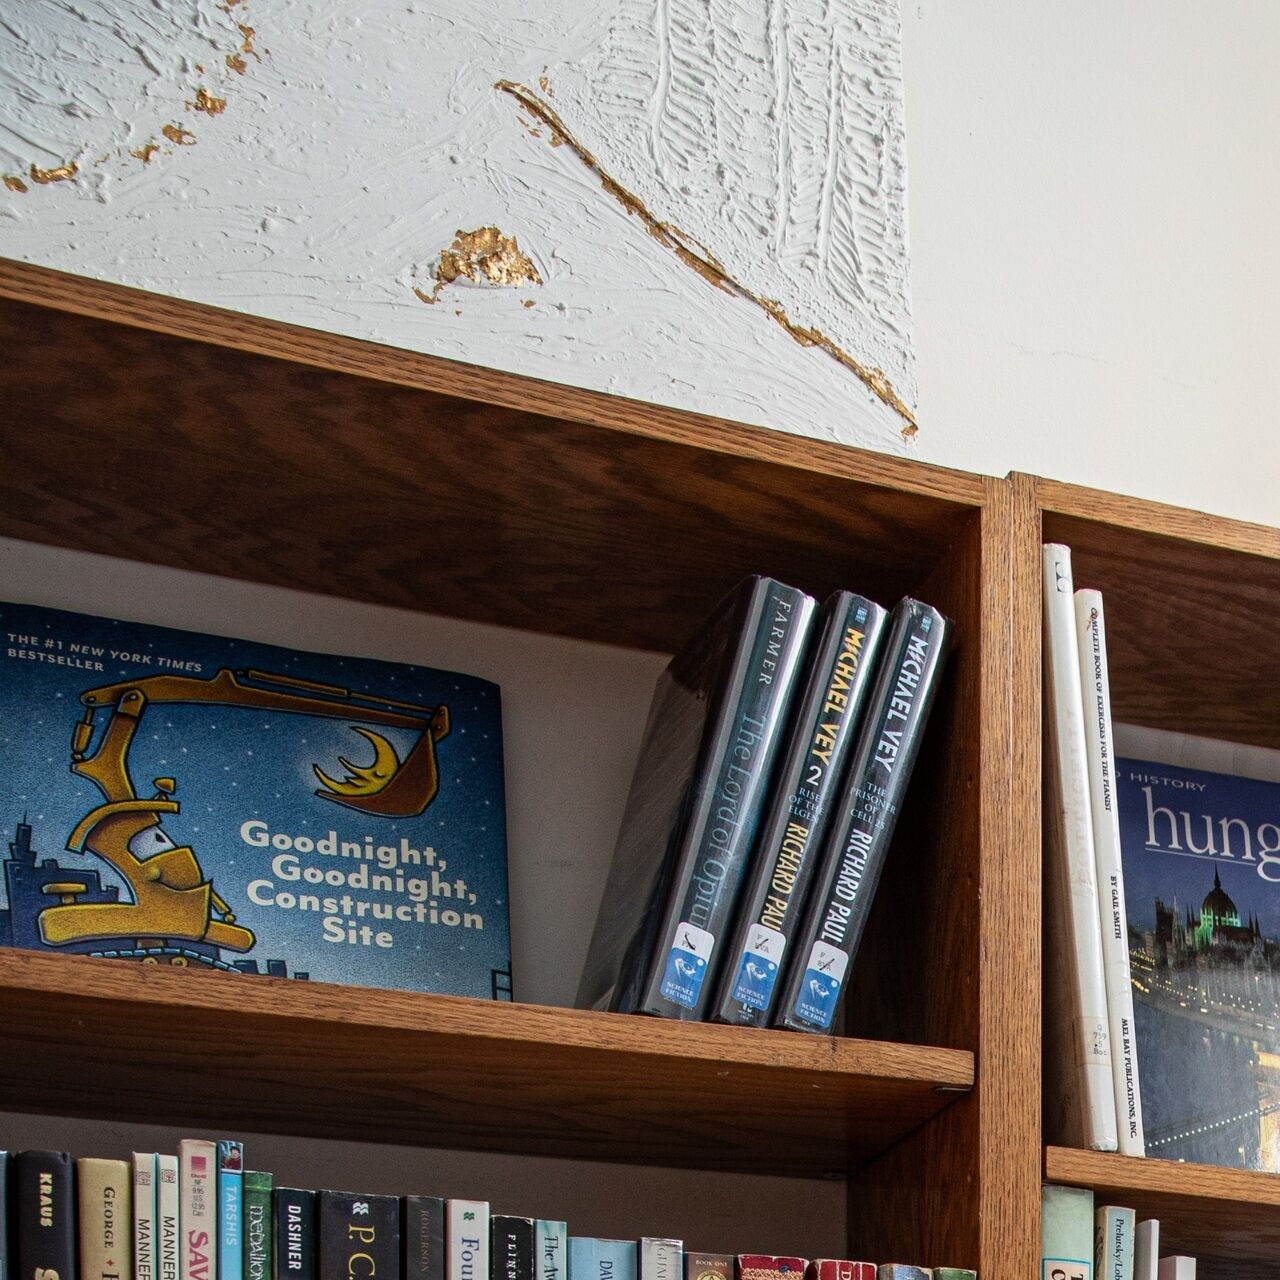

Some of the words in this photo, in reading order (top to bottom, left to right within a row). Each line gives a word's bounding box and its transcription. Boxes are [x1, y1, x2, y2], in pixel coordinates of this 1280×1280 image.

[8, 633, 38, 648] THE
[45, 637, 63, 650] #1
[70, 643, 104, 657] NEW
[110, 650, 153, 664] YORK
[158, 657, 202, 672] TIMES
[8, 649, 104, 672] BESTSELLER
[759, 598, 791, 685] FARMER
[824, 628, 865, 715] MICHAEL
[811, 721, 839, 765] VEY
[806, 765, 822, 786] 2
[1130, 771, 1206, 792] HISTORY
[240, 821, 447, 871] Goodnight,
[833, 829, 873, 899] RICHARD
[272, 855, 477, 905] Goodnight,
[1112, 892, 1120, 911] GAIL
[247, 881, 483, 930] Construction
[822, 901, 851, 944] PAUL
[1114, 913, 1122, 940] SMITH
[323, 918, 393, 948] Site
[39, 1173, 53, 1227] KRAUS
[225, 1186, 236, 1245] TARSHIS
[288, 1205, 302, 1270] DASHNER
[348, 1225, 375, 1246] P.
[348, 1252, 376, 1280] C.
